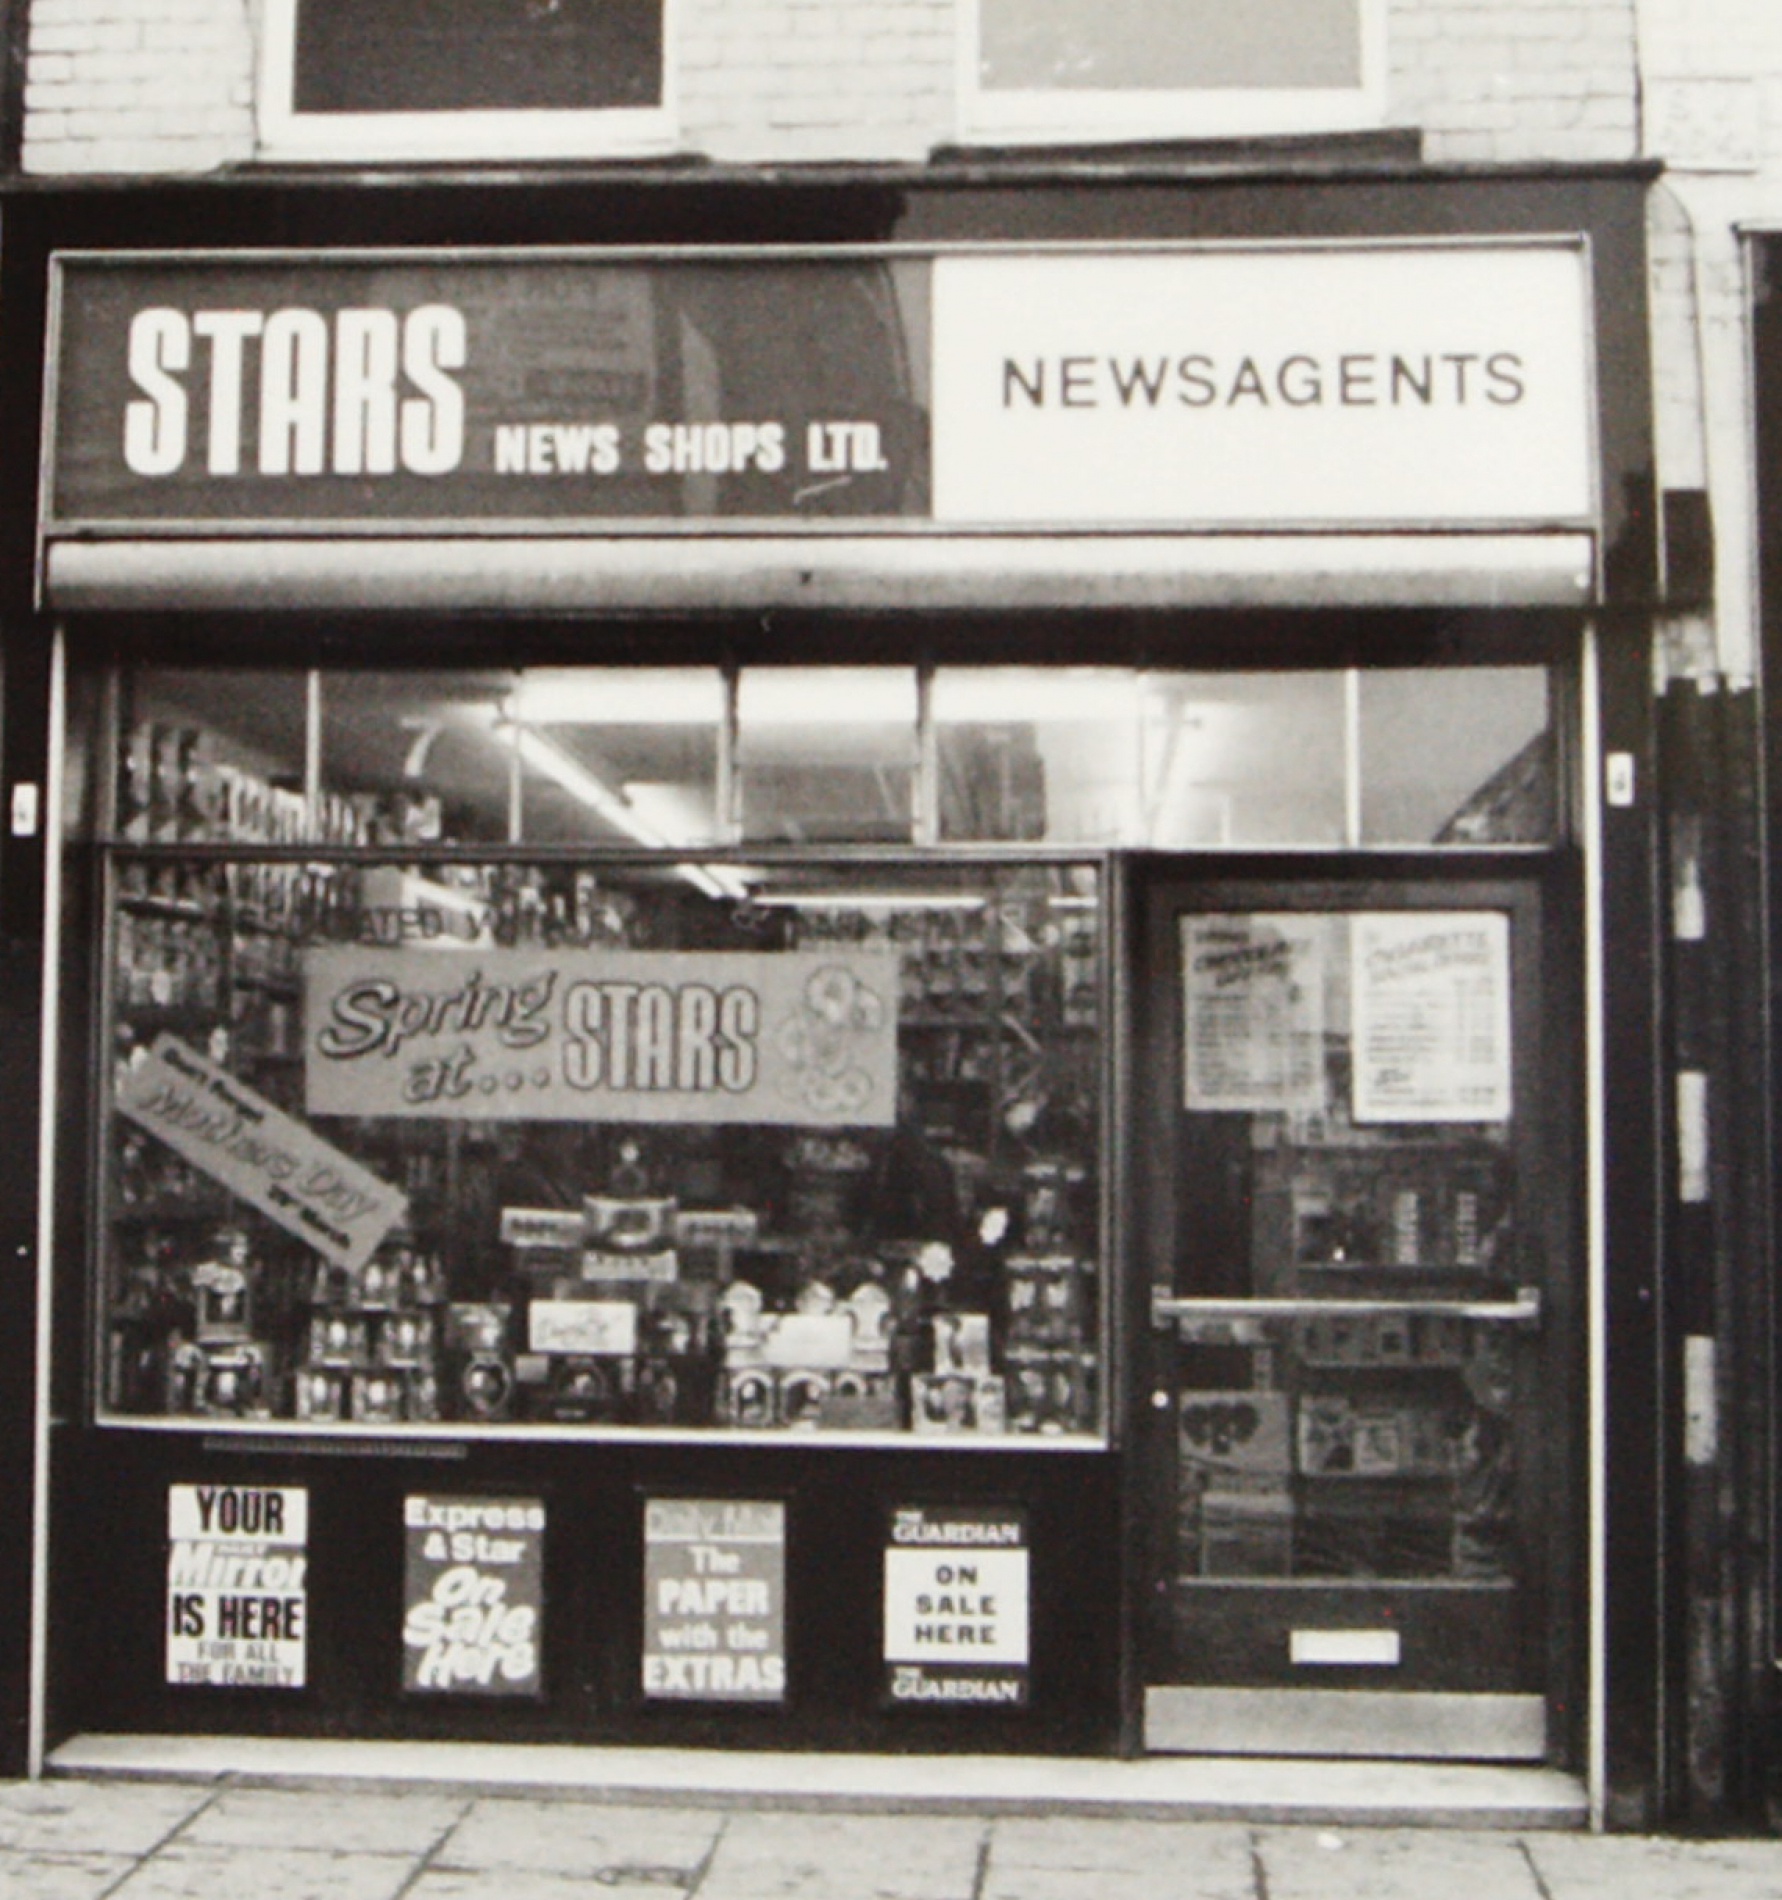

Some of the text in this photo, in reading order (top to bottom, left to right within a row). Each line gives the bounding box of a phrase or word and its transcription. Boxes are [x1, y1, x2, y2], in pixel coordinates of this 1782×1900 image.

[125, 304, 467, 475] STARS
[1003, 353, 1524, 408] NEWSAGENTS
[495, 423, 619, 474] NEWS
[644, 422, 784, 473] SHOPS
[318, 970, 759, 1092] Spring STARS
[196, 1487, 284, 1533] YOUR
[405, 1497, 544, 1532] Express
[450, 1533, 526, 1562] Star
[893, 1522, 1020, 1543] GUARDIAN
[689, 1545, 741, 1574] The
[936, 1565, 978, 1585] ON
[431, 1566, 507, 1606] On
[657, 1578, 770, 1615] PAPER
[173, 1594, 301, 1641] IS HERE
[916, 1595, 996, 1616] SALE
[404, 1602, 537, 1649] Sale
[658, 1622, 770, 1650] with the
[915, 1624, 995, 1645] HERE
[197, 1643, 279, 1662] FOR ALL
[416, 1640, 536, 1688] Here
[177, 1663, 294, 1686] THE FAMILY
[645, 1656, 784, 1691] EXTRAS
[891, 1679, 1019, 1701] GUARDIAN
